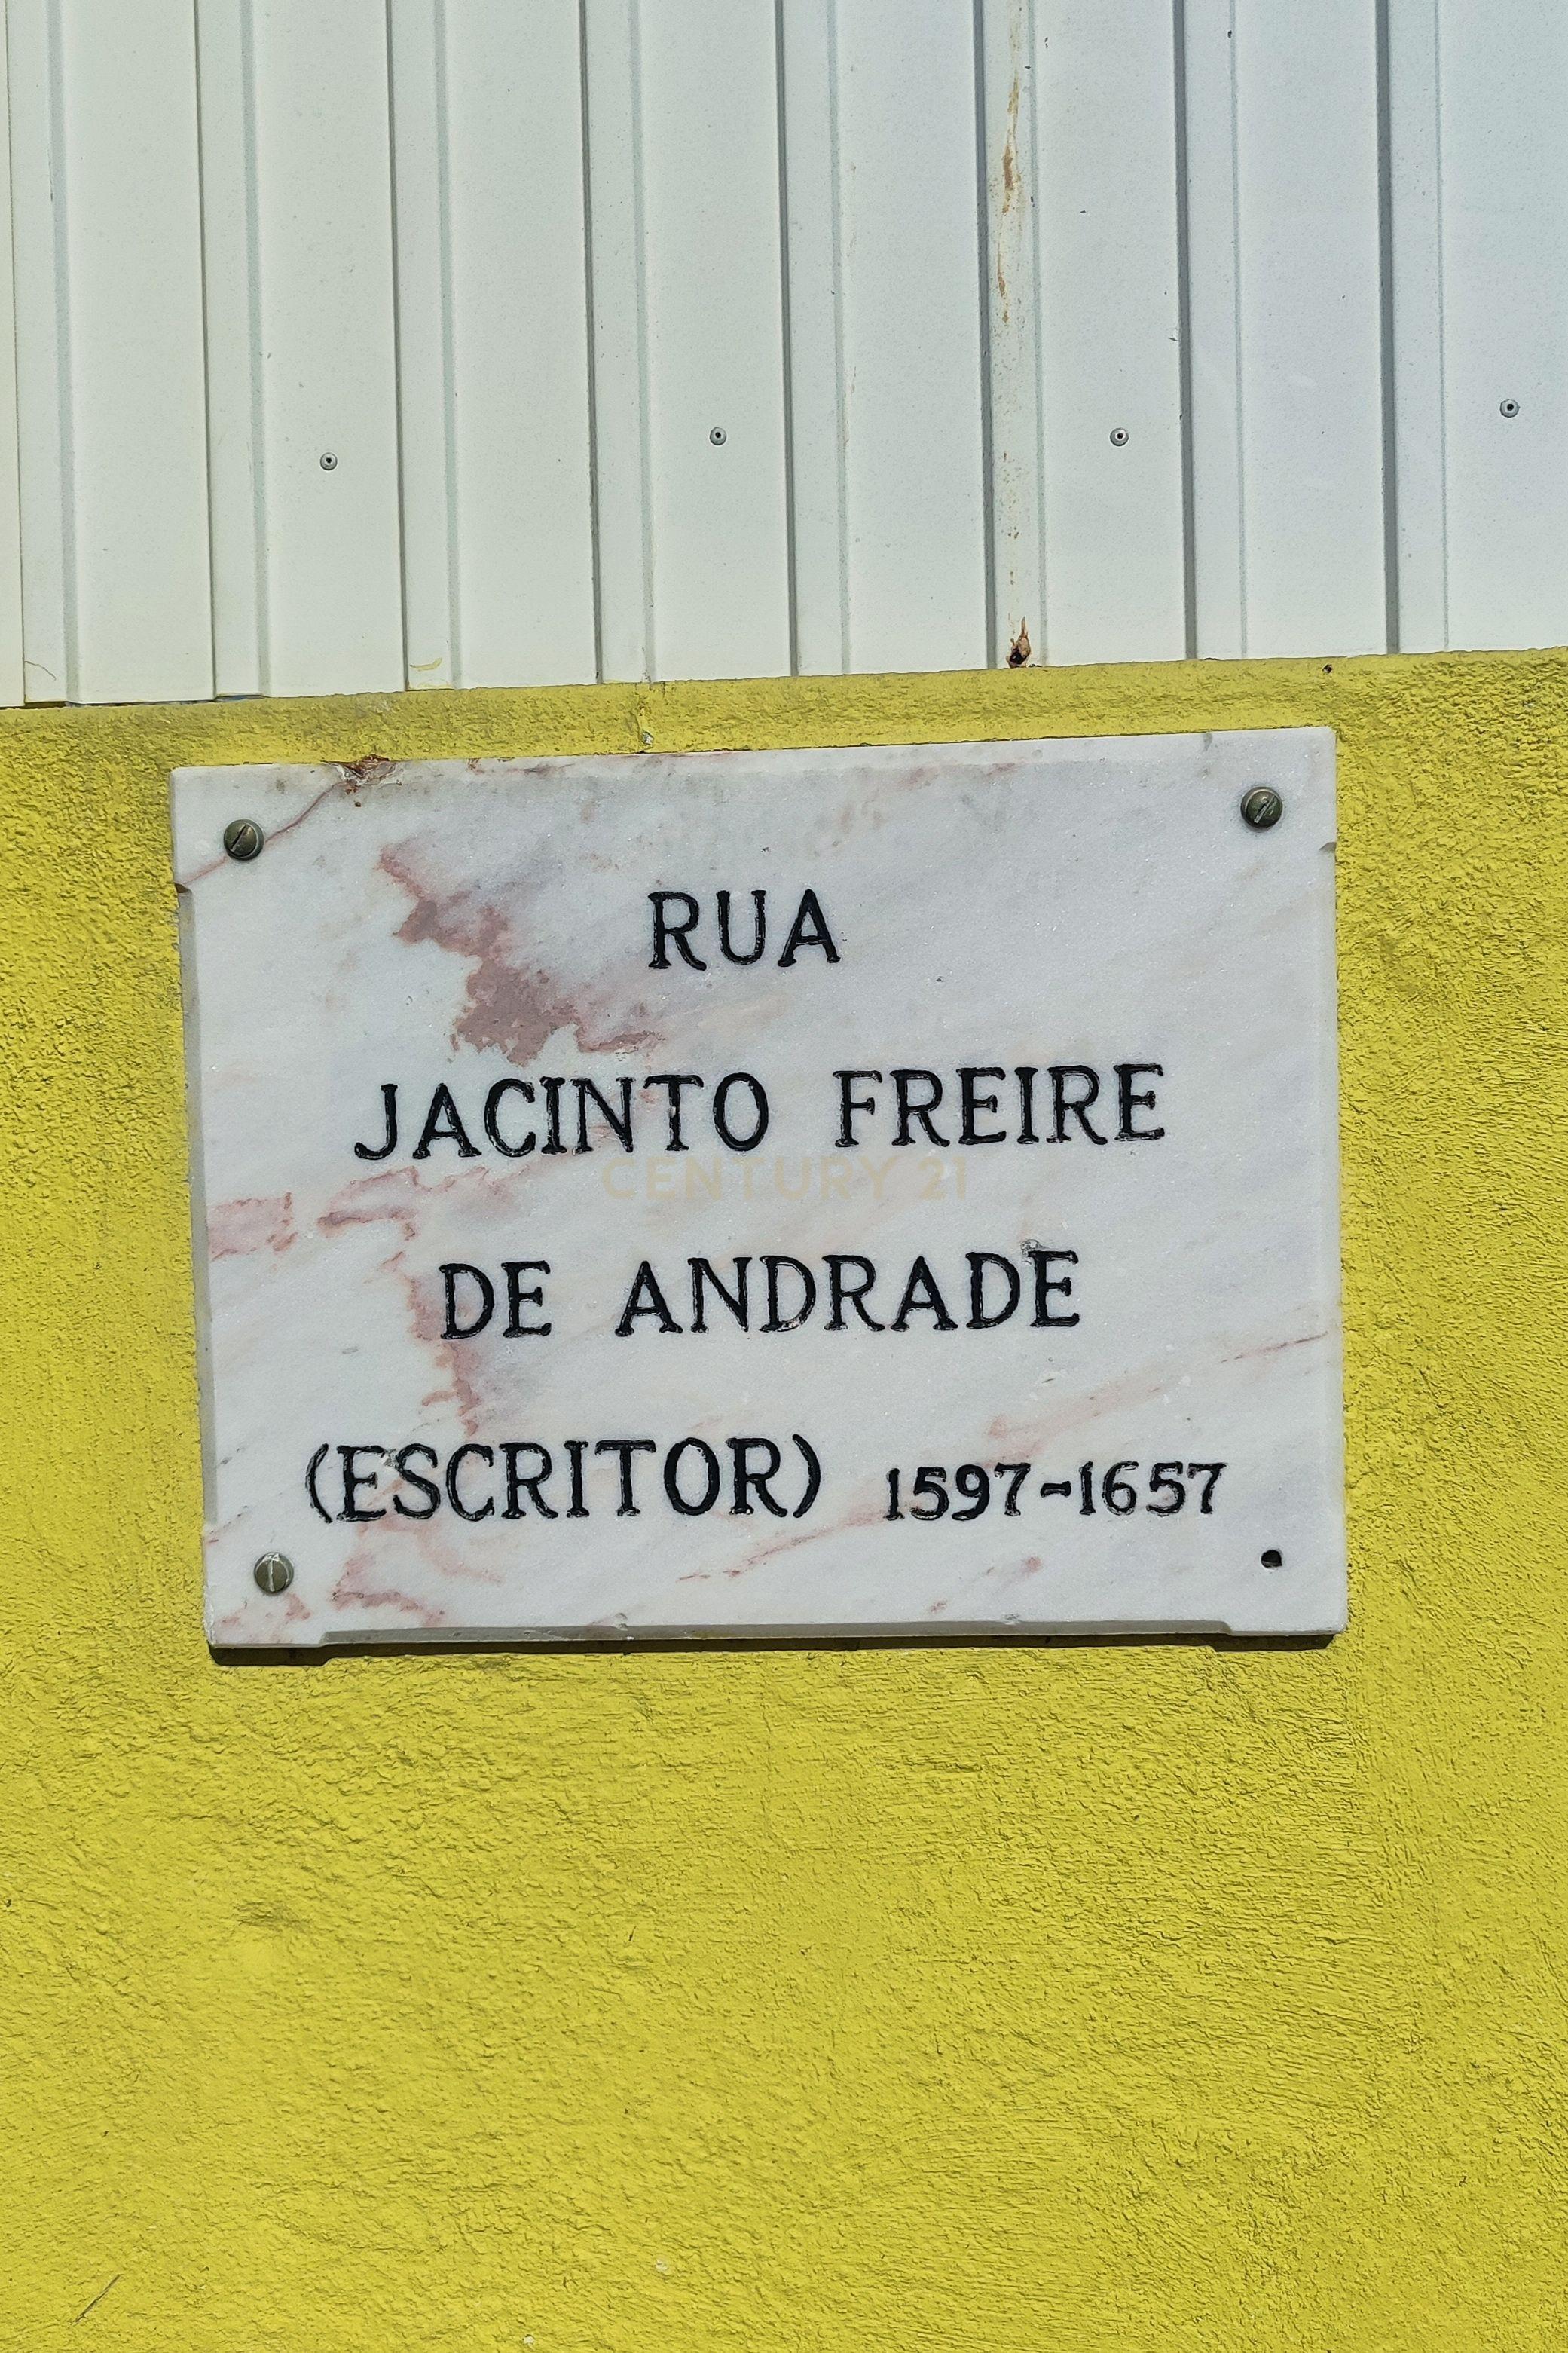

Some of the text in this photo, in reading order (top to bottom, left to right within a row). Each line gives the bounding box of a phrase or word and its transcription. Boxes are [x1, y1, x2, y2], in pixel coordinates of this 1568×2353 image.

[646, 888, 841, 972] RUA
[354, 1063, 1166, 1161] JACINTO FREIRE
[438, 1250, 1080, 1341] DE ANDRADE
[305, 1434, 1227, 1525] (ESCRITOR) 1597-1657
